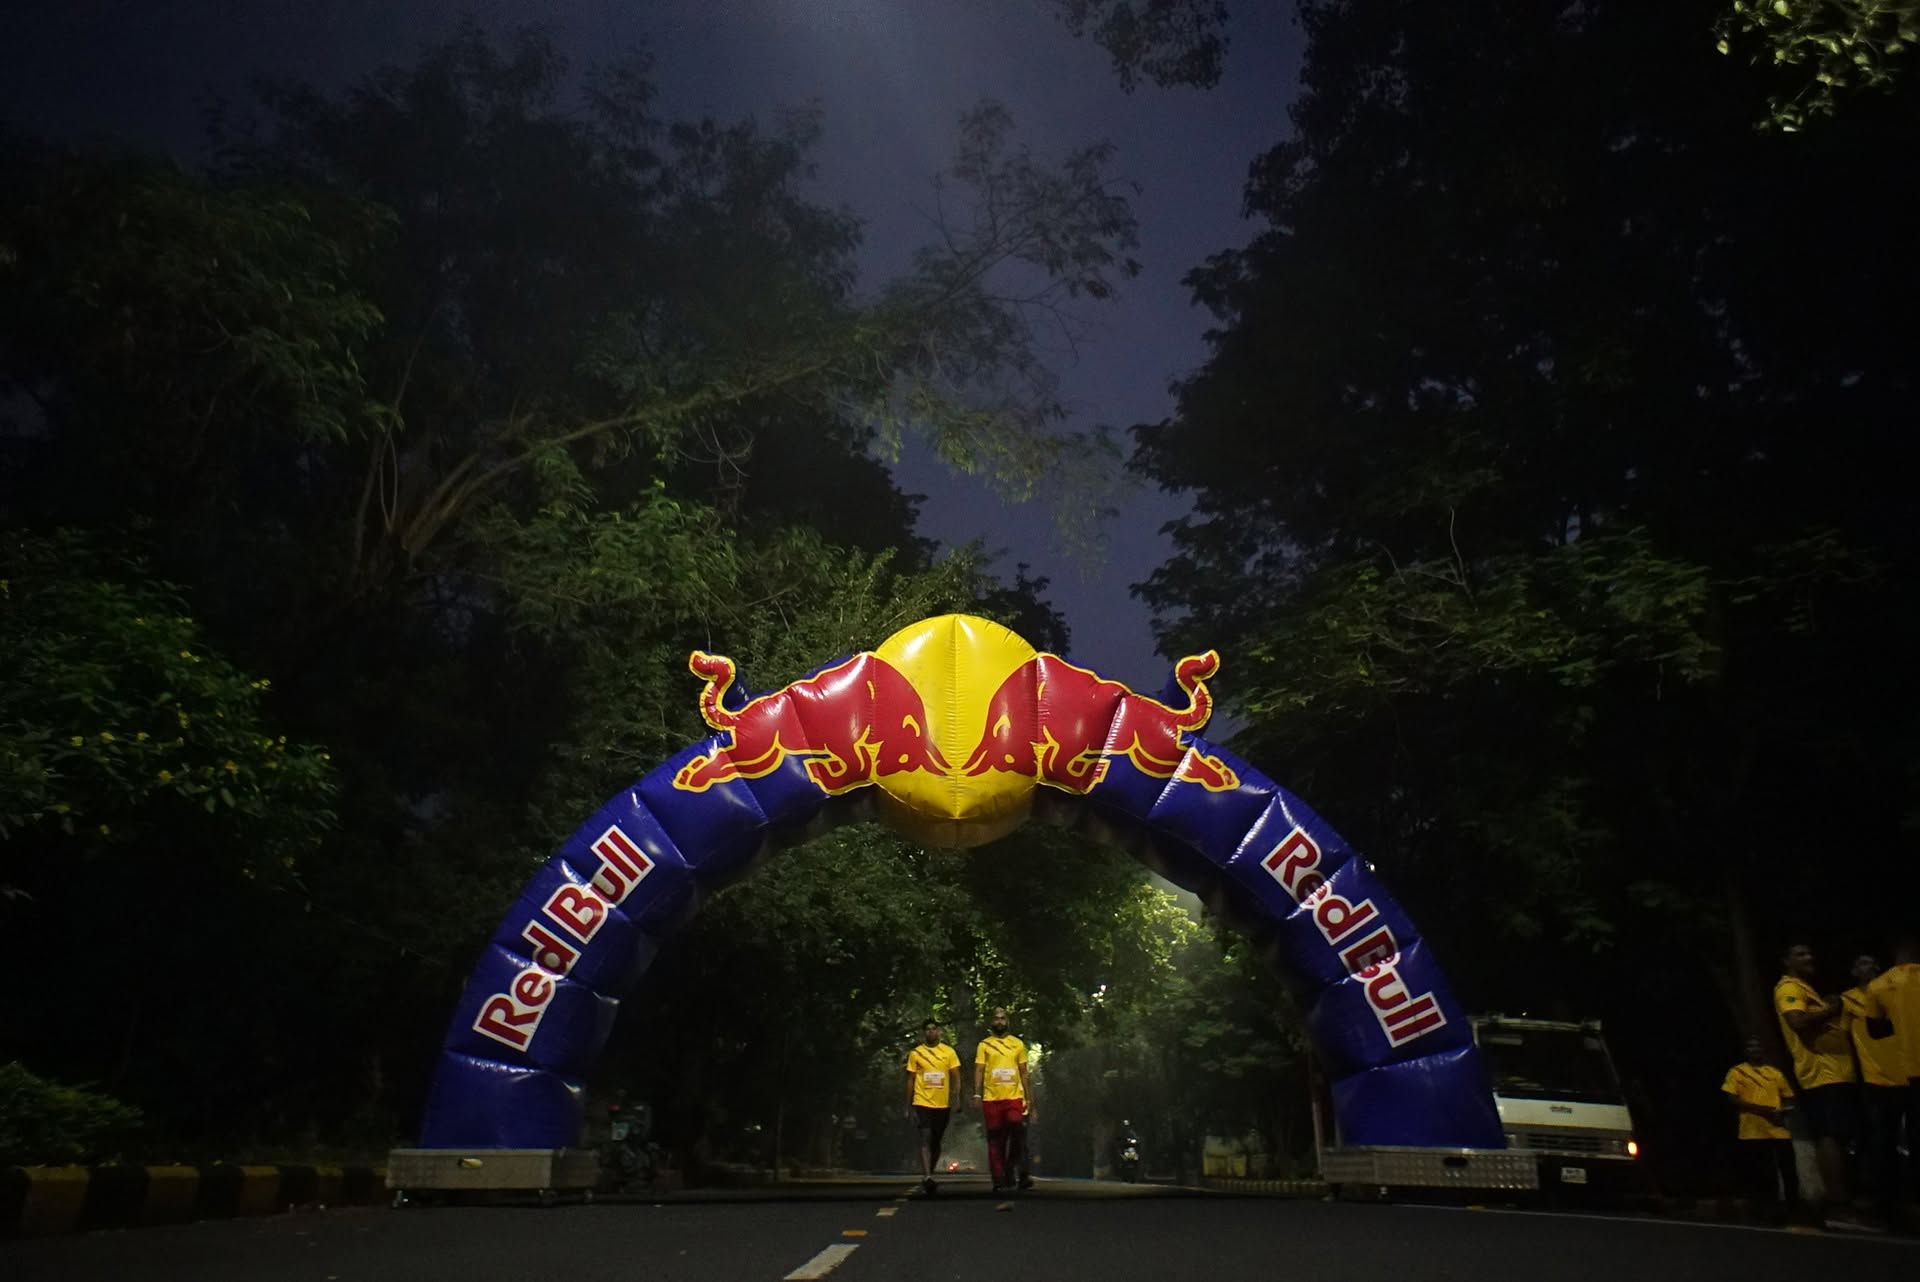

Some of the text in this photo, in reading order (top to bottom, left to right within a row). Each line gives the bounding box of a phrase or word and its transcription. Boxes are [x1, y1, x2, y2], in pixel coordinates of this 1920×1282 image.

[472, 824, 656, 1053] Red Bull
[1260, 826, 1447, 1048] Red Bull
